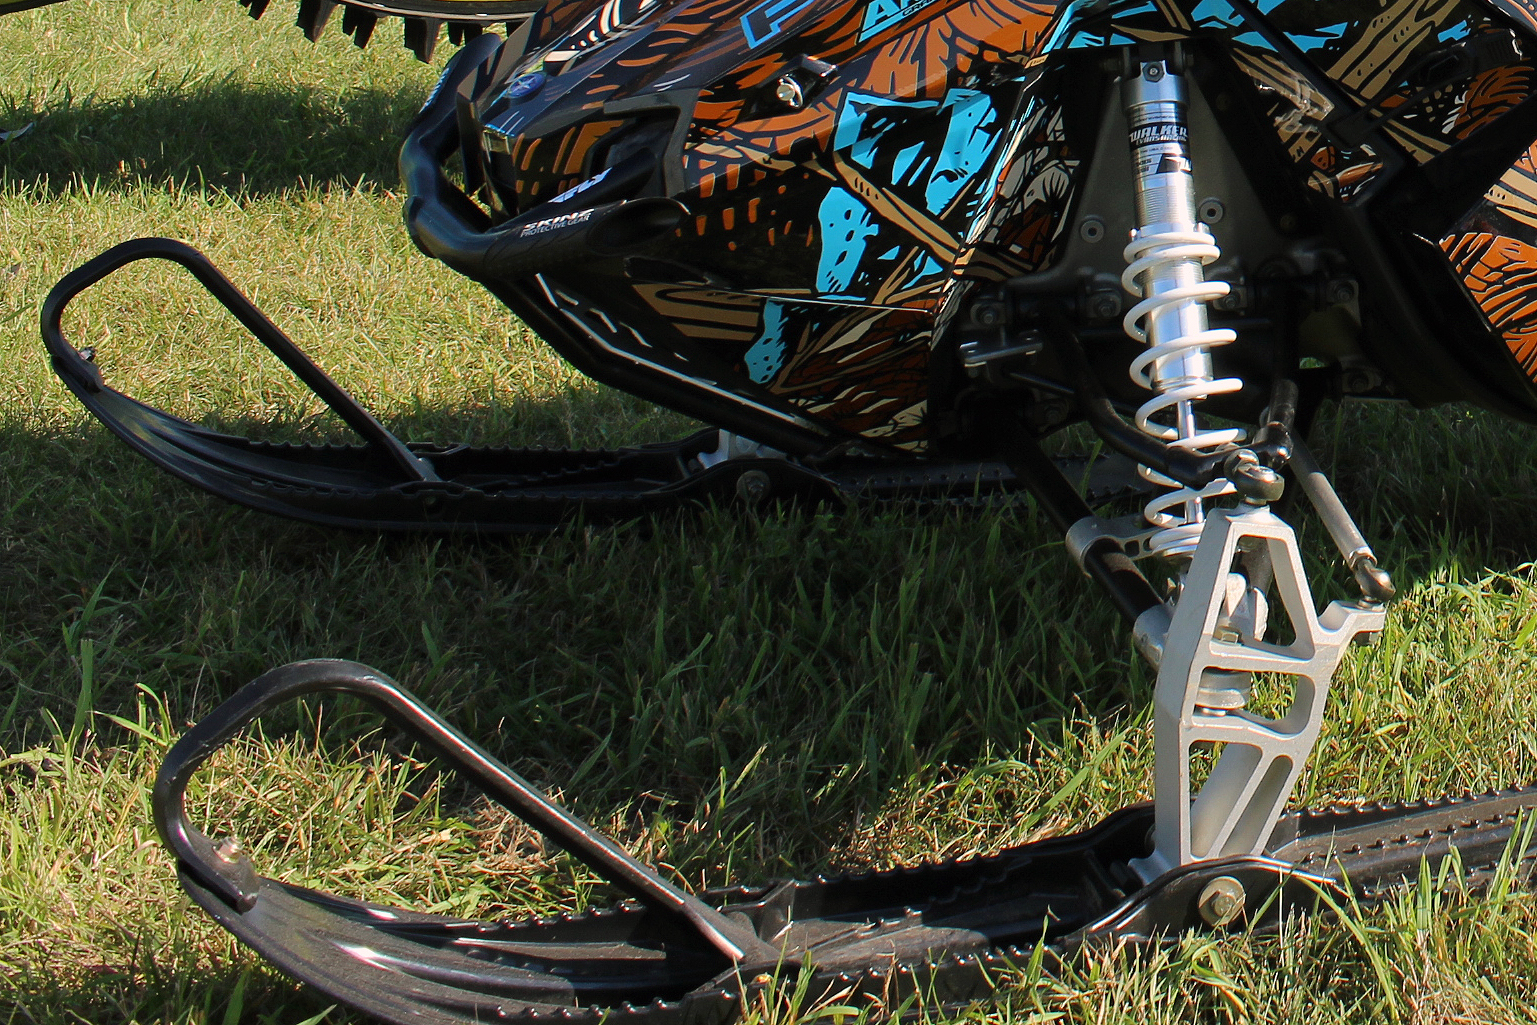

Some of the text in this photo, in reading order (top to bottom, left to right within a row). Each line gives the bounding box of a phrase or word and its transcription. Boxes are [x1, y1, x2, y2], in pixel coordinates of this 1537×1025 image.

[1129, 124, 1188, 143] WALKER
[520, 213, 594, 238] PROTECTIVE GEAR
